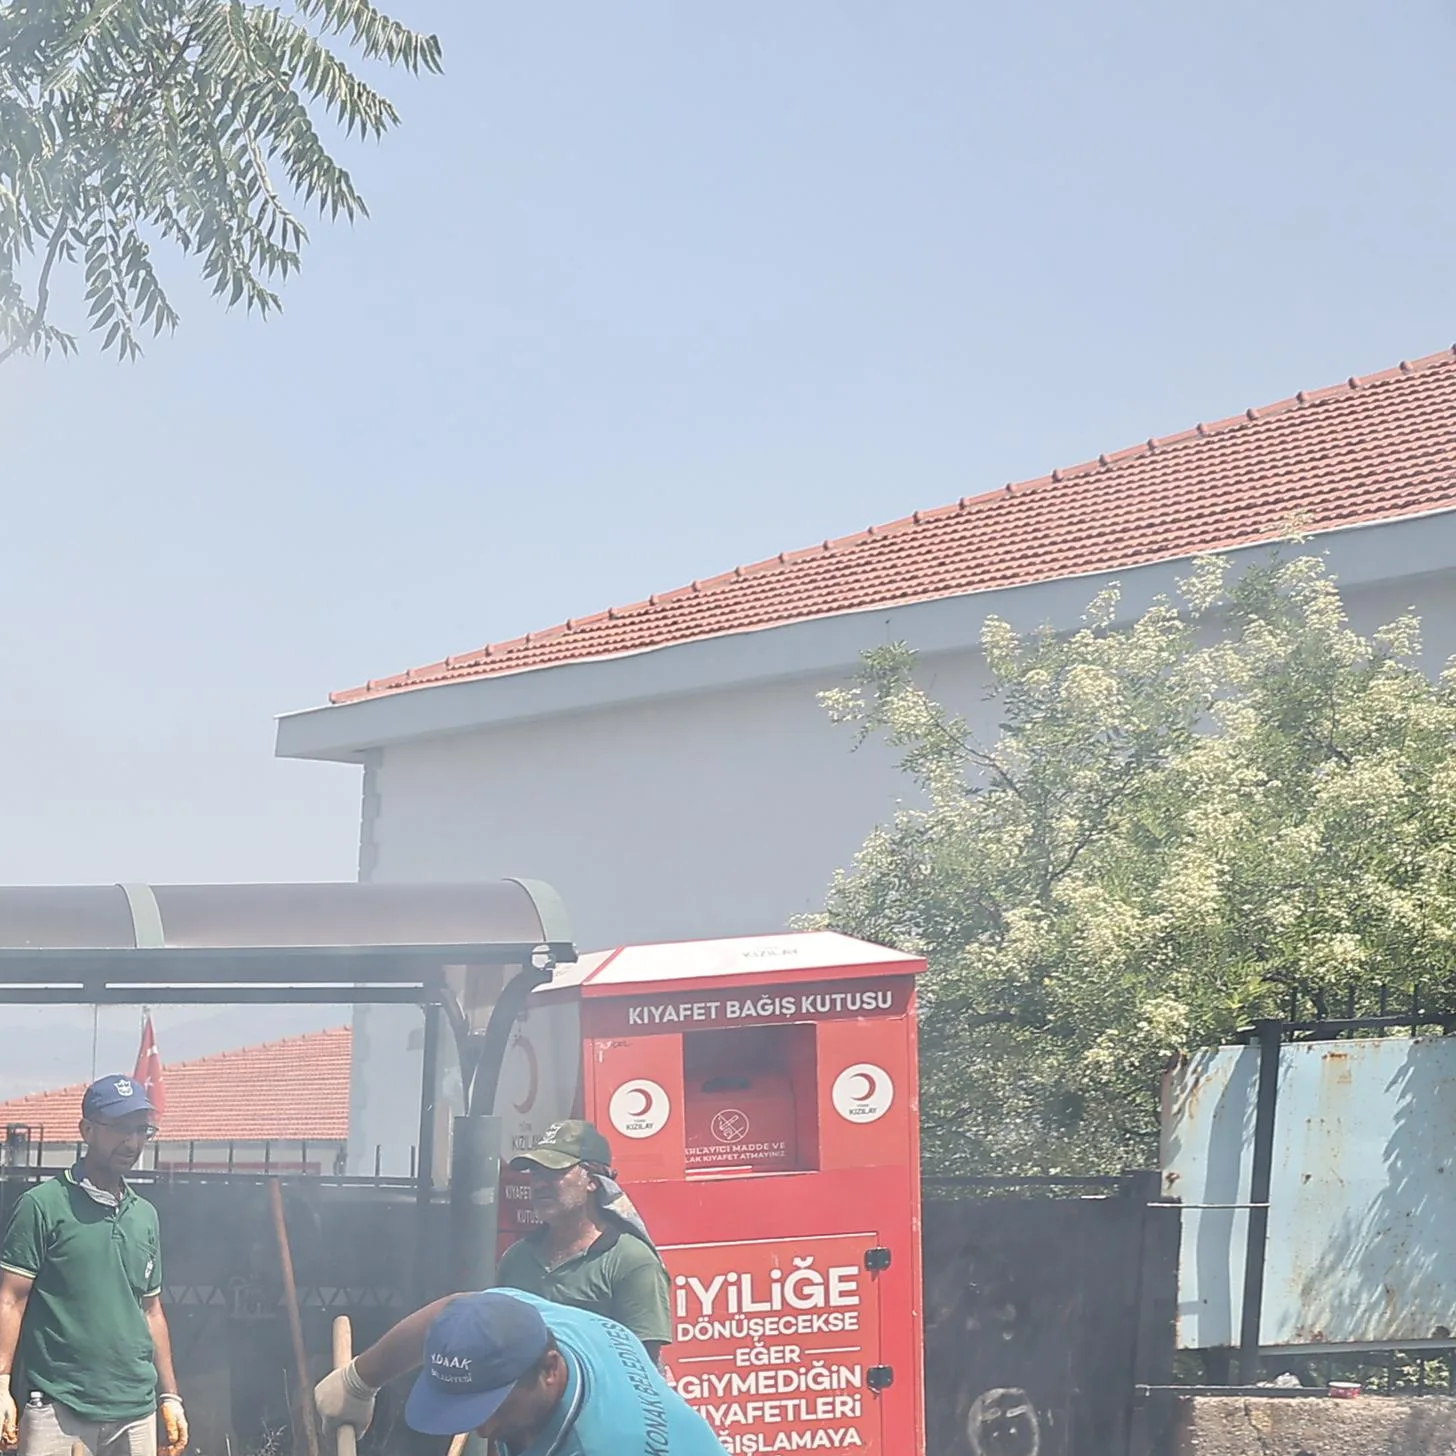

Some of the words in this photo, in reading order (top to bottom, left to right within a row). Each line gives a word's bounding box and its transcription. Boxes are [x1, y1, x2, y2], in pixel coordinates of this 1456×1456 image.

[628, 1001, 721, 1025] KIYAFET
[725, 994, 796, 1018] BAĞIŞ
[801, 991, 893, 1014] KUTUSU
[684, 1155, 702, 1164] LAK
[703, 1153, 739, 1162] KIYAFET
[732, 1142, 769, 1153] MADDE
[771, 1141, 786, 1150] VE
[677, 1311, 859, 1342] DÖNÜŞECEKSE
[735, 1341, 801, 1367] EĞER
